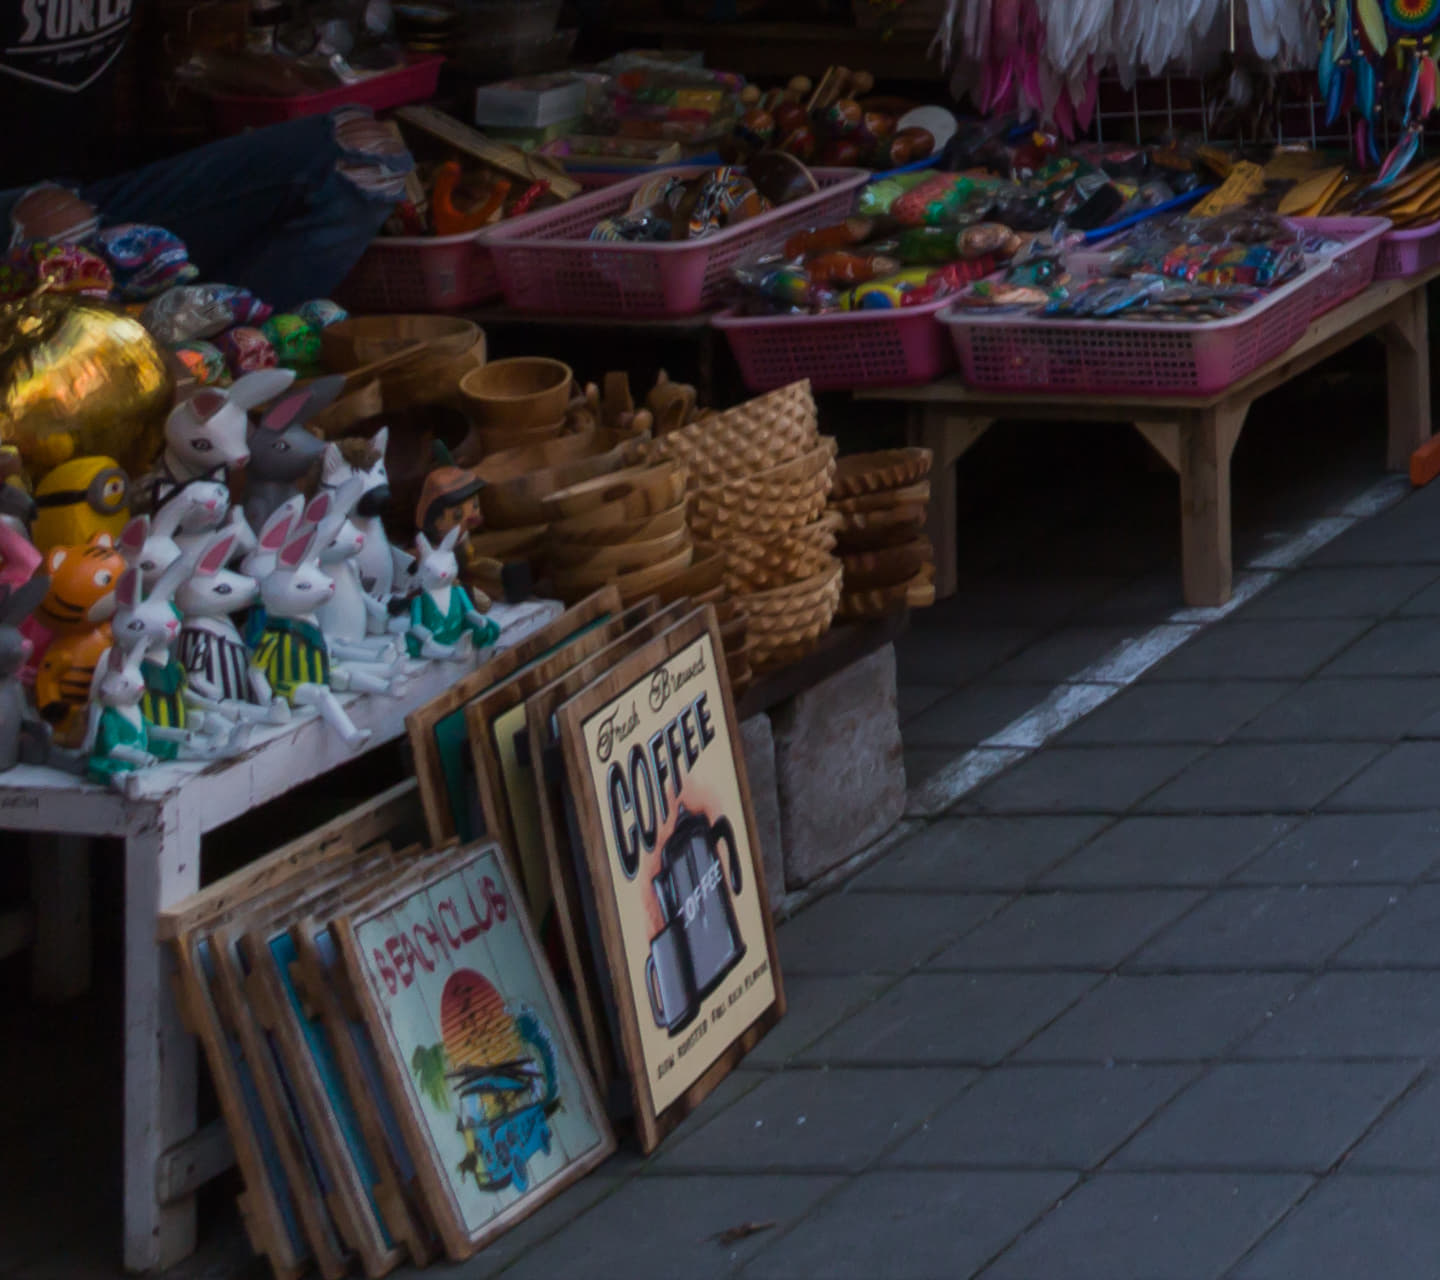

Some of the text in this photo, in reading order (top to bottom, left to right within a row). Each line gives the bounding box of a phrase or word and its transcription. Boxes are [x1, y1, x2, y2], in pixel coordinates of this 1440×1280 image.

[596, 643, 707, 763] Fresh Brewed
[606, 690, 716, 881] COFFEE
[373, 875, 507, 996] BEACH CLUB
